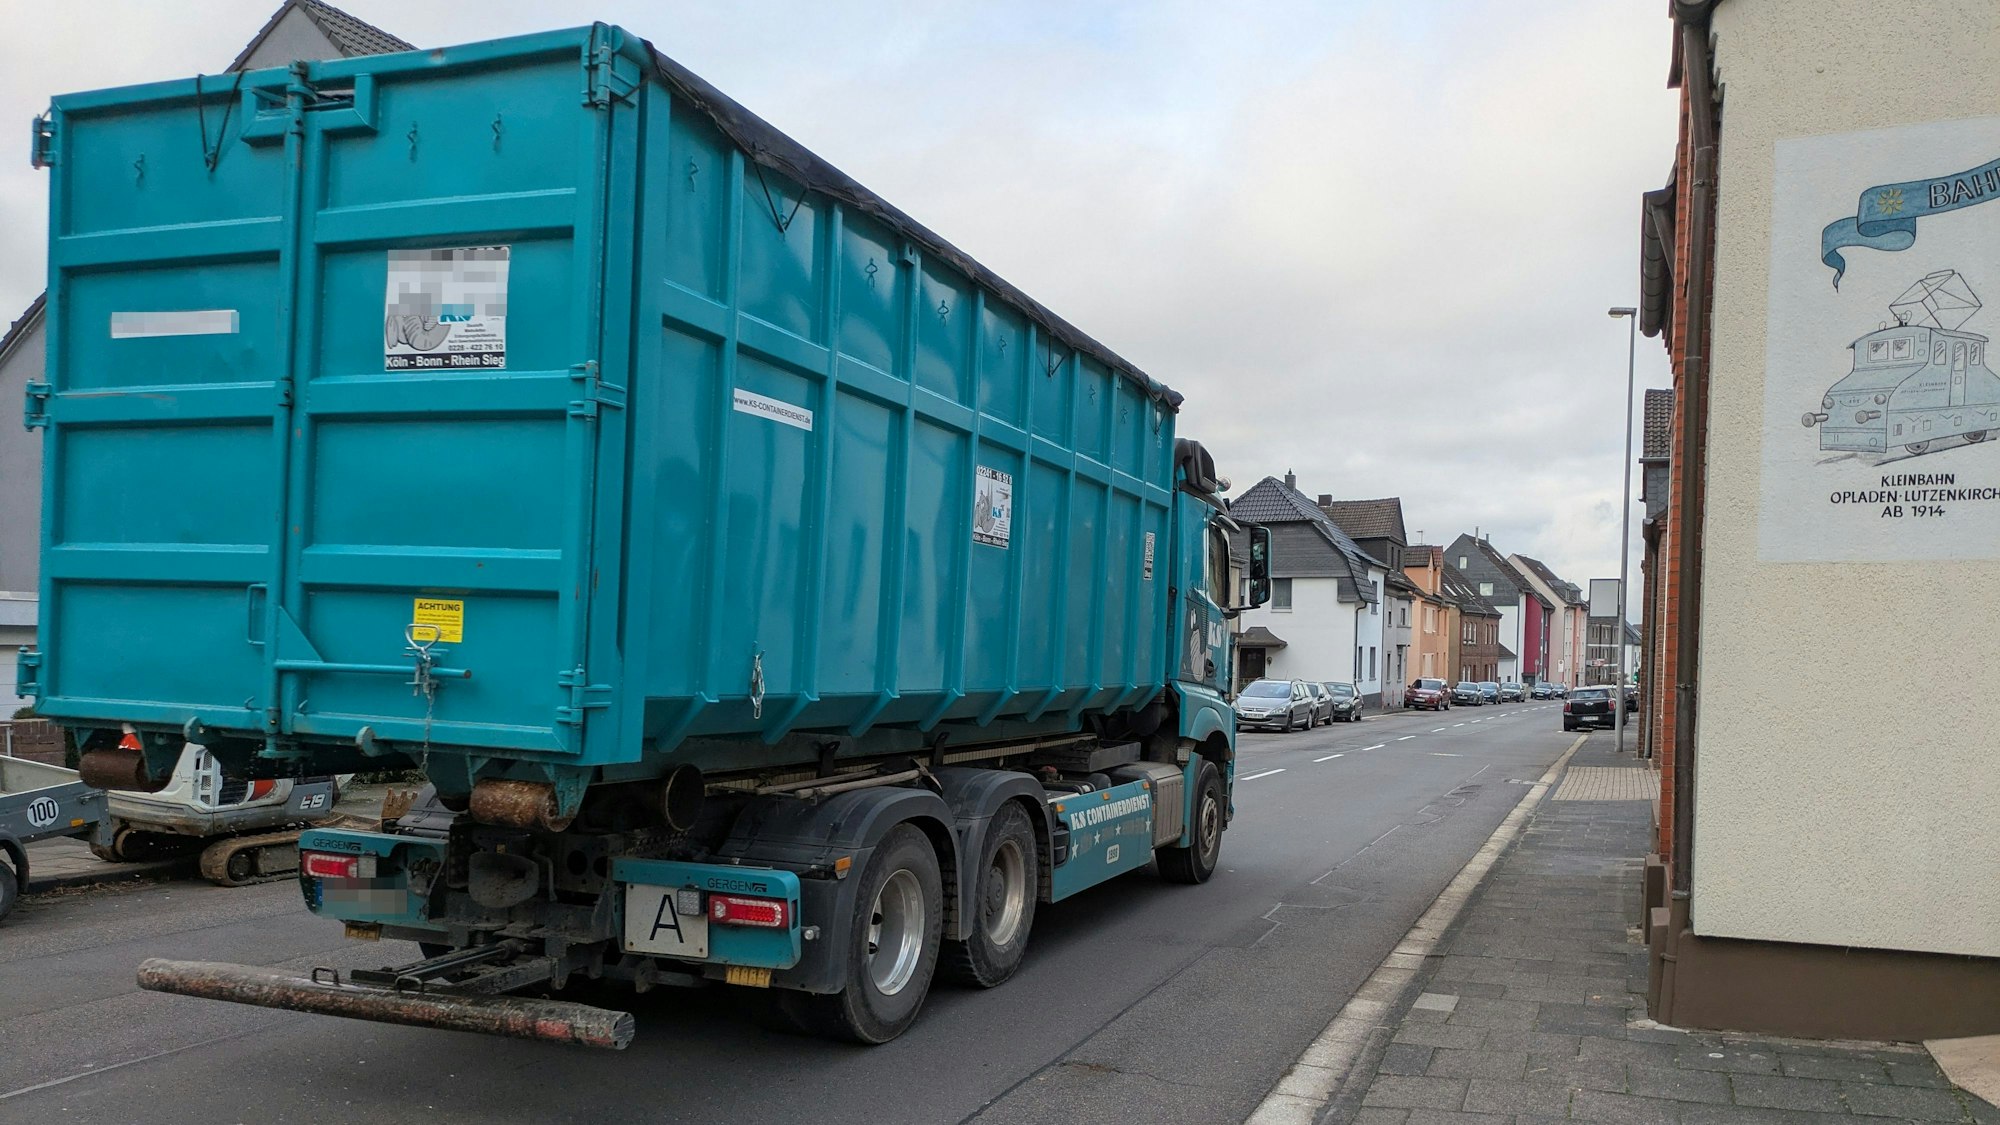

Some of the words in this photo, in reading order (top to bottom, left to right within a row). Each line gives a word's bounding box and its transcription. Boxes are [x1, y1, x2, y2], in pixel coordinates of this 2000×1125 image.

[1928, 167, 2000, 208] BAH
[386, 356, 409, 368] Köln
[416, 355, 443, 367] Bonn
[451, 354, 480, 366] Rhein
[482, 354, 505, 367] Sieg
[1881, 473, 1955, 487] KLEINBAHN
[1881, 506, 1904, 518] AB
[1911, 505, 1946, 518] 1914
[417, 602, 460, 612] ACHTUNG
[1207, 621, 1222, 648] KS
[29, 800, 56, 823] 100
[1086, 794, 1149, 826] CONTAINERDIENST
[313, 838, 351, 850] GERGEN
[707, 877, 752, 892] GERGEN
[649, 894, 684, 944] A
